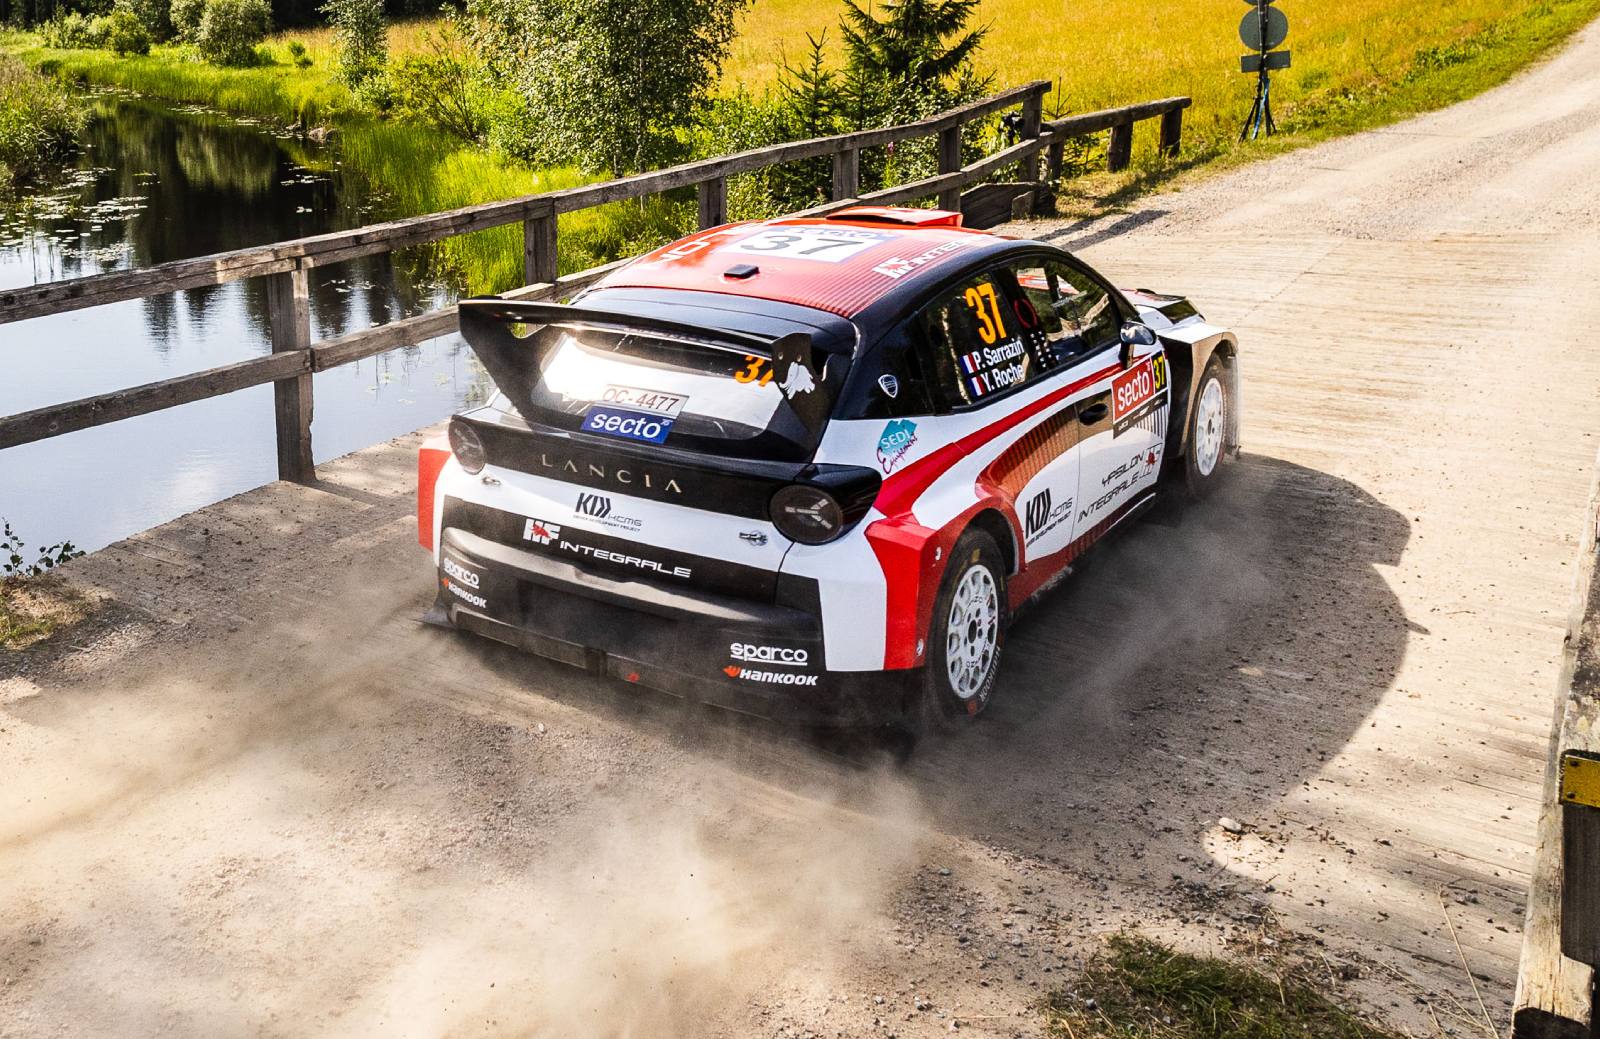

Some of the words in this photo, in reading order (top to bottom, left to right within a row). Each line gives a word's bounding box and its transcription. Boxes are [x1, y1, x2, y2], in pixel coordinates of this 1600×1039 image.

[740, 234, 865, 255] 37
[965, 281, 1007, 345] 37
[973, 350, 986, 371] P.
[984, 337, 1026, 367] Sarrazin
[993, 364, 1025, 388] Roche
[1153, 355, 1166, 390] 37
[602, 387, 680, 413] OC-4477
[1117, 369, 1151, 412] secto
[590, 412, 661, 439] secto
[880, 427, 913, 450] SEDI
[541, 453, 682, 494] LANCIA
[443, 556, 480, 589] sparco
[559, 540, 692, 579] INTEGRALE
[729, 642, 808, 666] sparco
